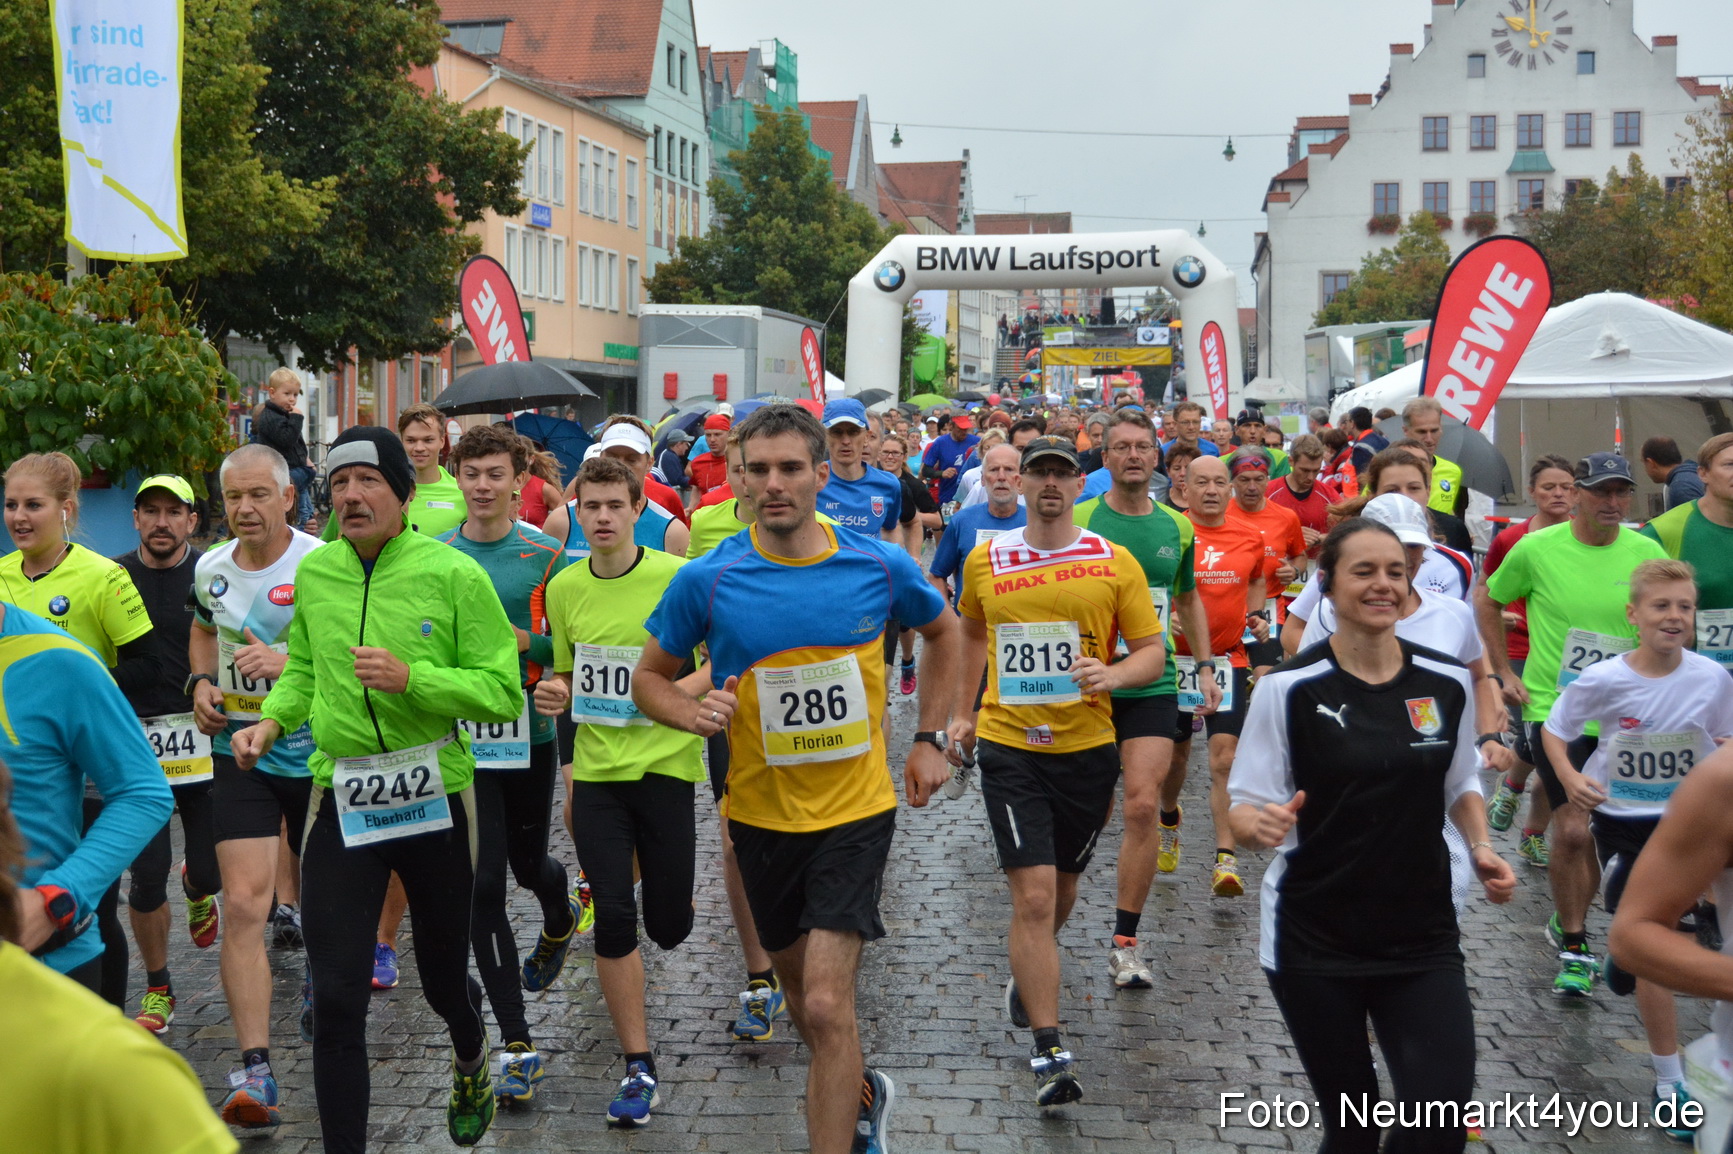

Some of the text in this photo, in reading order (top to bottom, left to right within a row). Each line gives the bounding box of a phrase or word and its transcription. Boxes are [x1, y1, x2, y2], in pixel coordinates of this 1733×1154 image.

[90, 20, 144, 48] sind
[916, 244, 1161, 275] BMW Laufsport
[471, 279, 519, 362] WE
[1434, 262, 1533, 423] REWE
[1093, 351, 1122, 362] ZIEL
[1204, 332, 1225, 410] REWE
[825, 502, 840, 510] MIT
[994, 563, 1116, 596] MAX BÖGL
[1029, 625, 1071, 636] BOCK
[1004, 642, 1072, 673] 2813
[802, 661, 851, 681] BOCK
[1177, 669, 1227, 690] 214
[1020, 681, 1054, 694] Ralph
[238, 698, 262, 710] Clau
[780, 684, 848, 727] 286
[1187, 695, 1204, 705] Rola
[793, 734, 844, 751] Florian
[378, 748, 429, 768] BOCK
[1617, 748, 1695, 780] 3093
[344, 765, 435, 807] 2242
[364, 806, 427, 828] Eberhard
